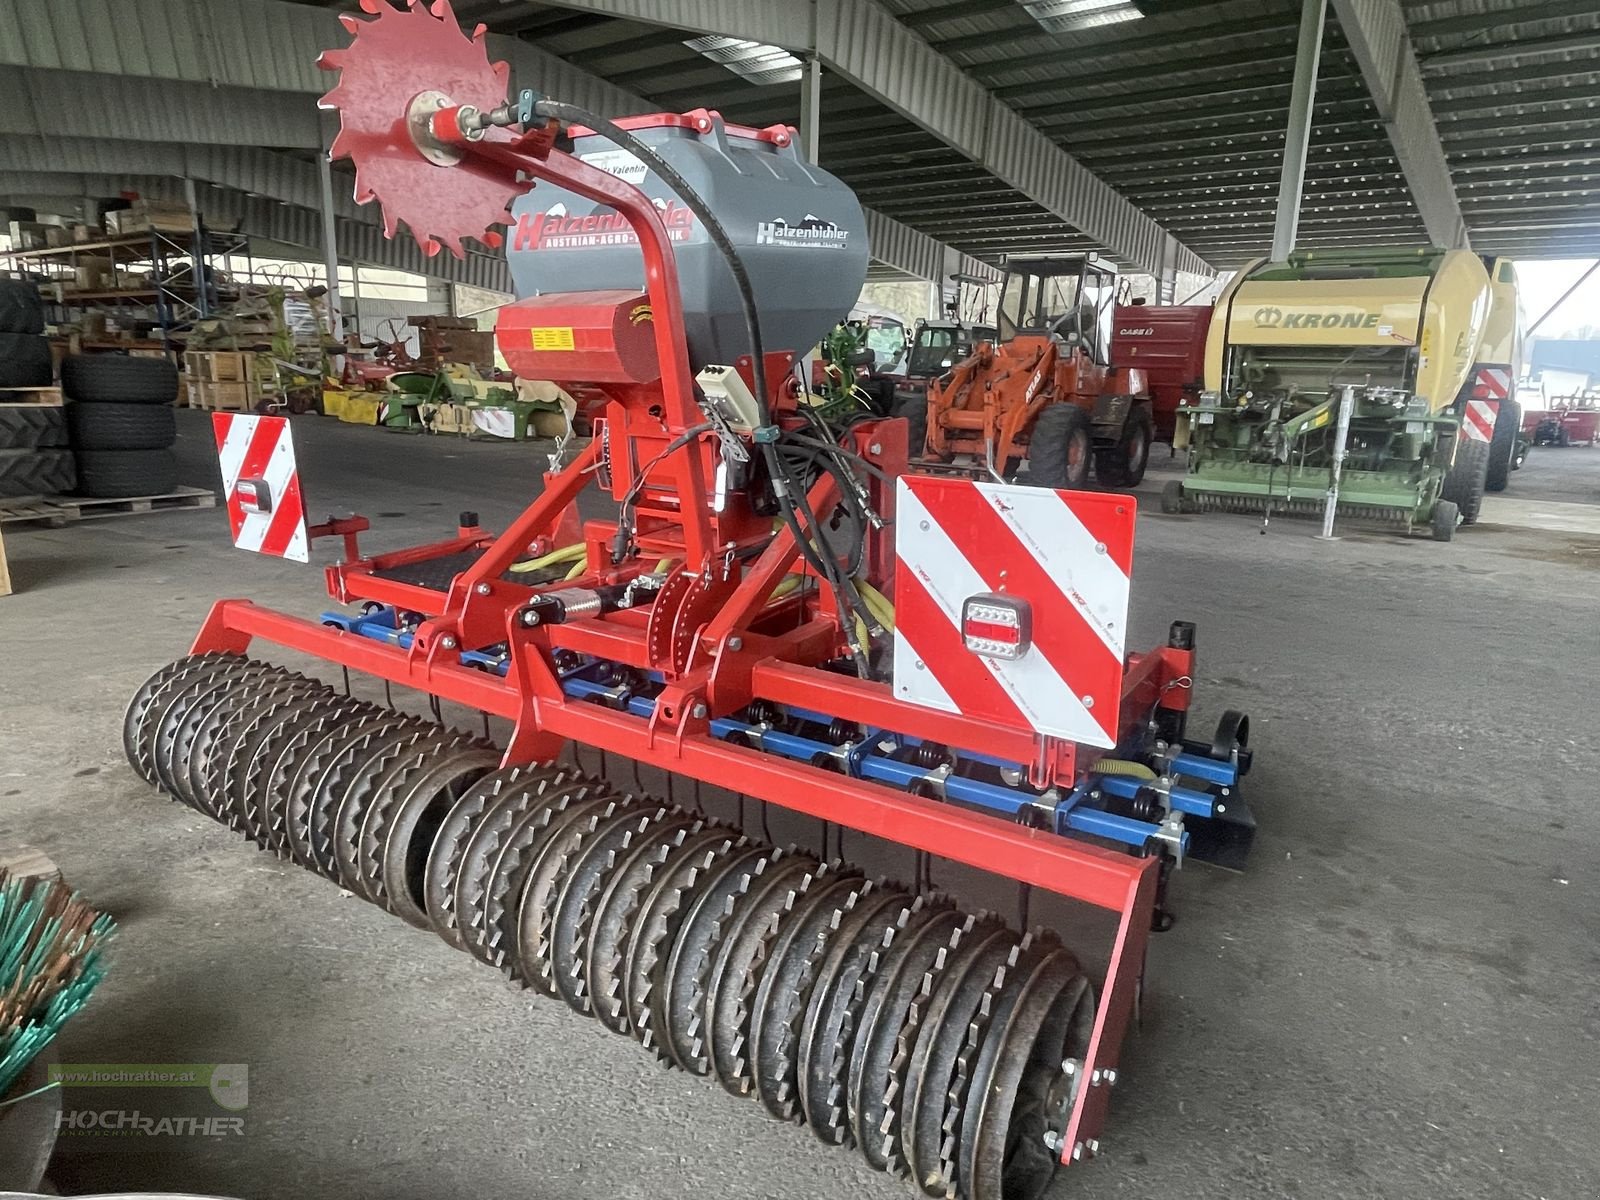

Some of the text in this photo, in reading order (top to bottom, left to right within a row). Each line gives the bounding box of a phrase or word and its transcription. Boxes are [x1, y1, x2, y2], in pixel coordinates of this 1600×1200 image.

[613, 165, 646, 175] Valentin
[513, 200, 693, 251] Hatzenbler
[756, 222, 849, 244] Hatzenbichler
[1282, 313, 1382, 328] KRONE
[1120, 328, 1145, 336] CASE
